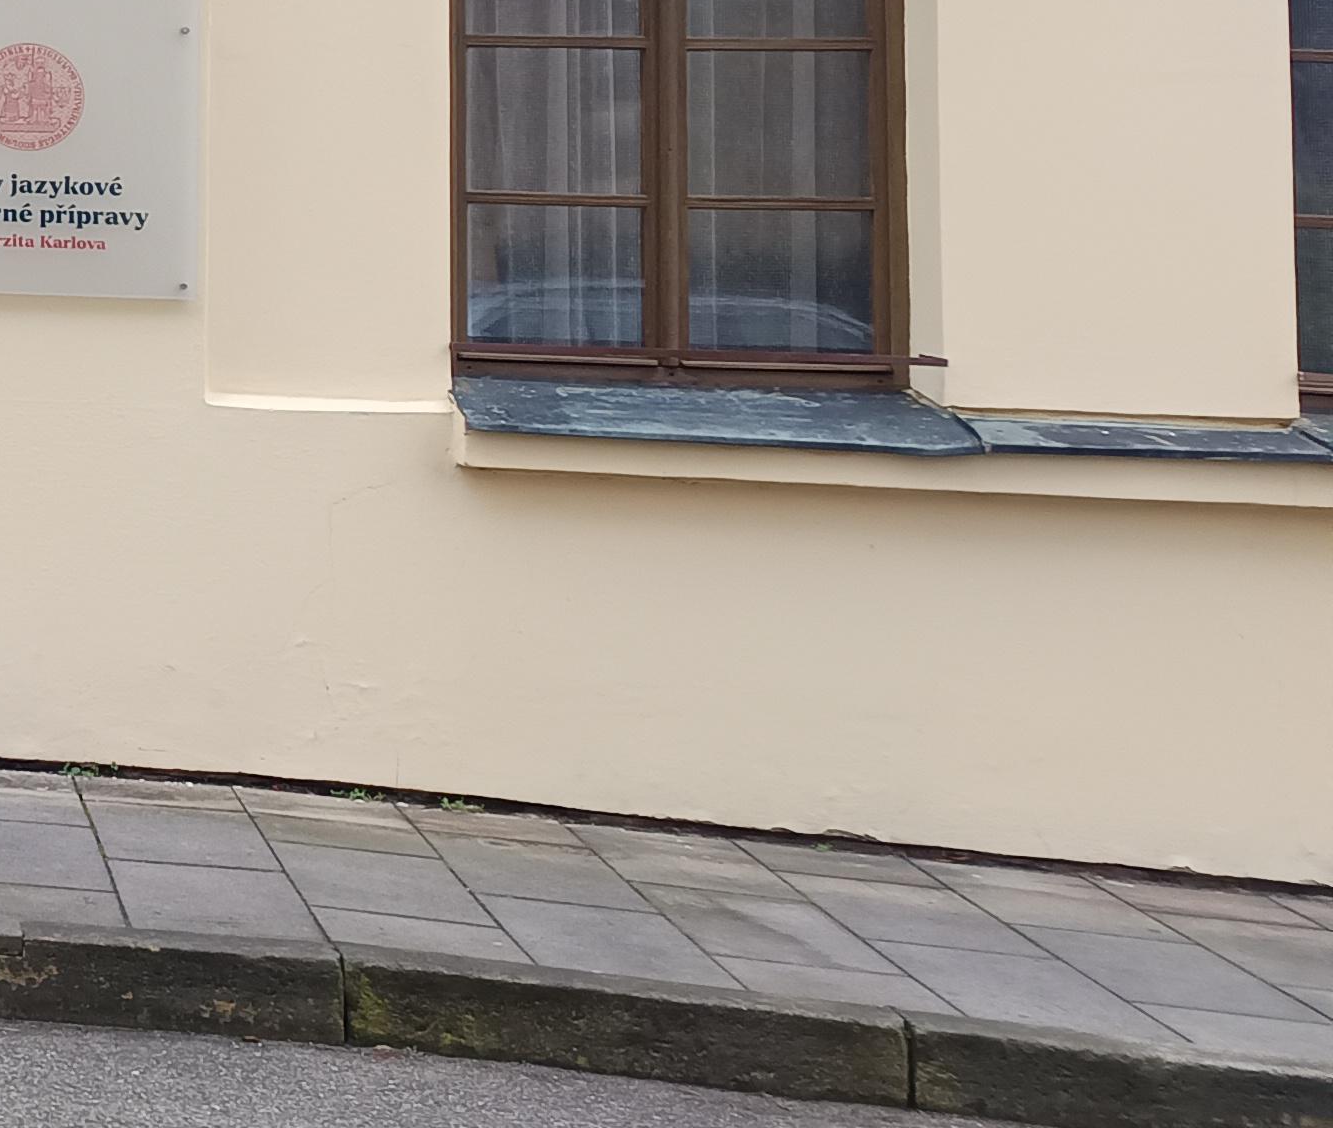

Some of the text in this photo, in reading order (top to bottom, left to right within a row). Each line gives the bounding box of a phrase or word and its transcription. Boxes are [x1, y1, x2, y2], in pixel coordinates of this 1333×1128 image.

[10, 173, 123, 199] jazykové
[39, 203, 149, 230] přípravy
[40, 234, 107, 250] Karlova
